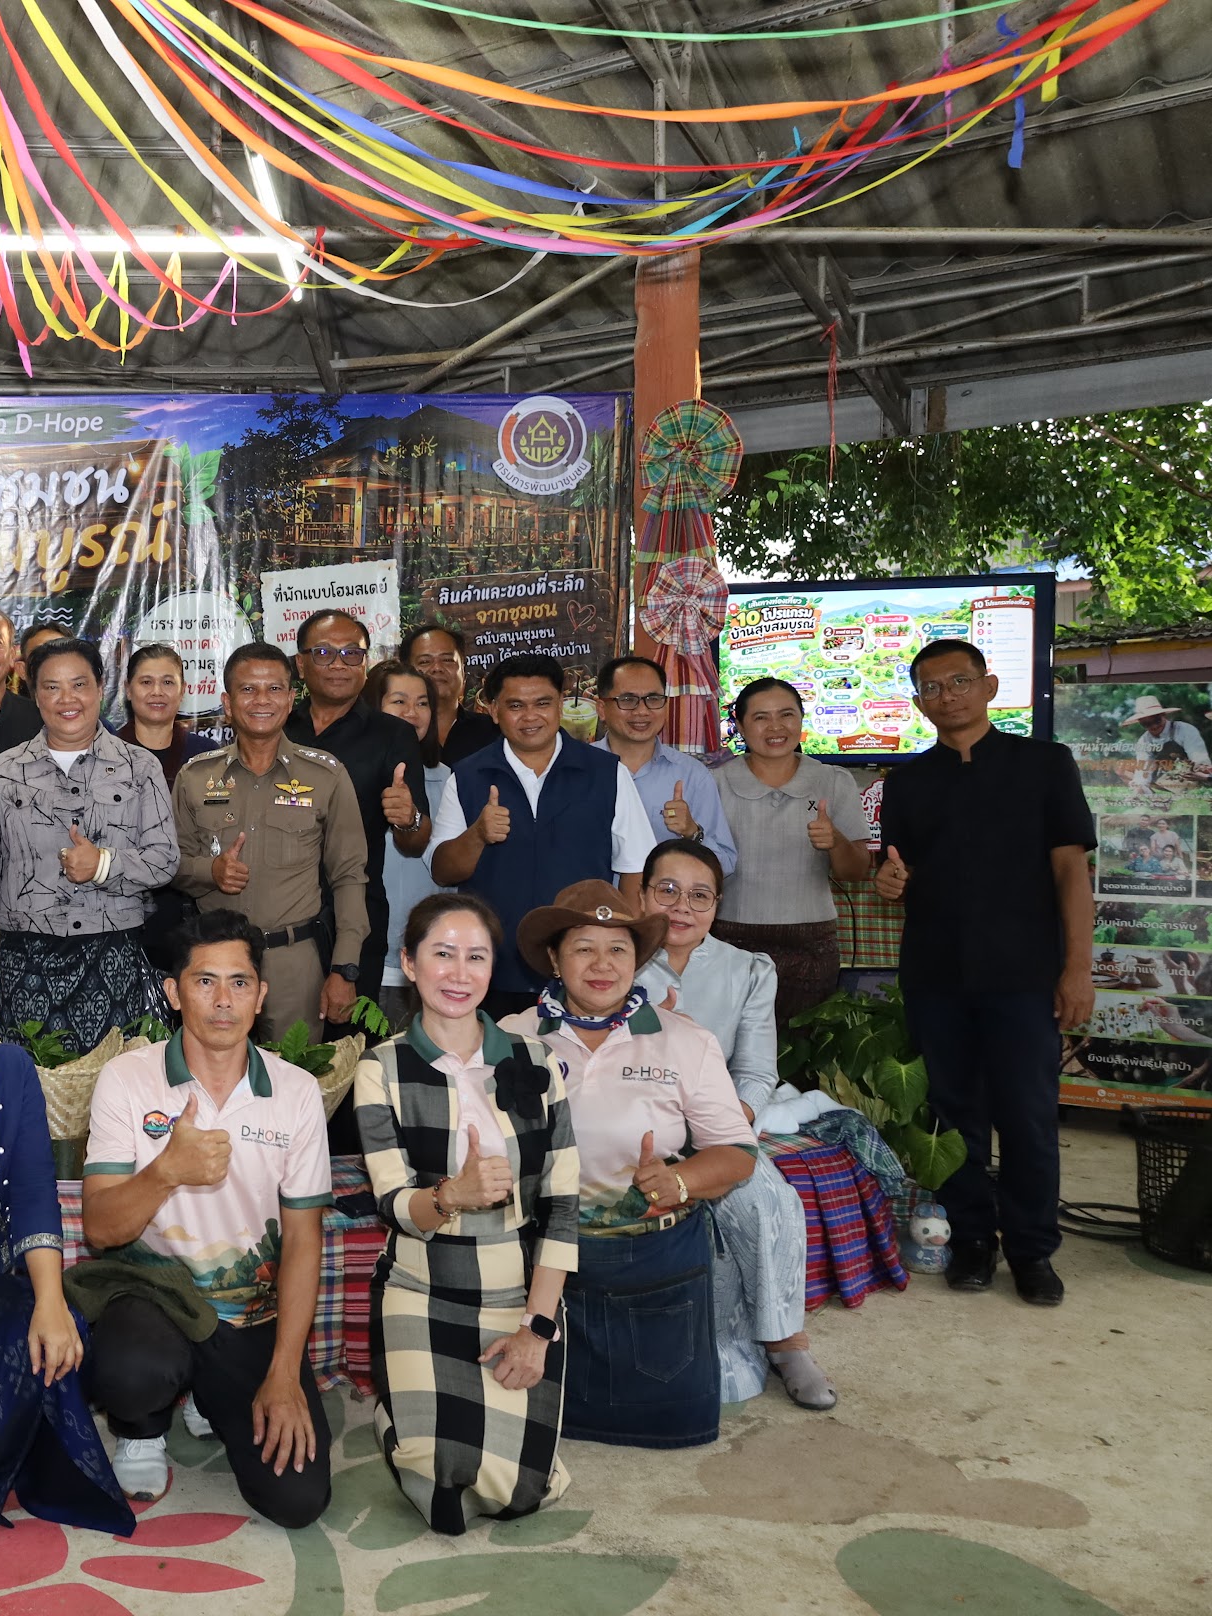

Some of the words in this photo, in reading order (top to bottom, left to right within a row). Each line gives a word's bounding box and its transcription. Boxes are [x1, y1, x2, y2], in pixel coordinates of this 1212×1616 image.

[14, 413, 104, 438] D-Hope
[496, 462, 588, 492] กรมการพัฒนาชุมชน
[273, 577, 388, 603] ที่พักแบบโฮมสเตย์
[438, 572, 585, 605] สินค้าและของที่ระลึก
[475, 602, 558, 627] จากชุมชน
[736, 610, 761, 627] 10
[761, 607, 813, 621] โปรแกรม
[475, 626, 555, 648] สนับสนุนชุมชน
[730, 618, 816, 639] บ้านสุขสมบูรณ์
[622, 1066, 679, 1080] D-HOPE
[241, 1124, 290, 1146] D-HOPE
